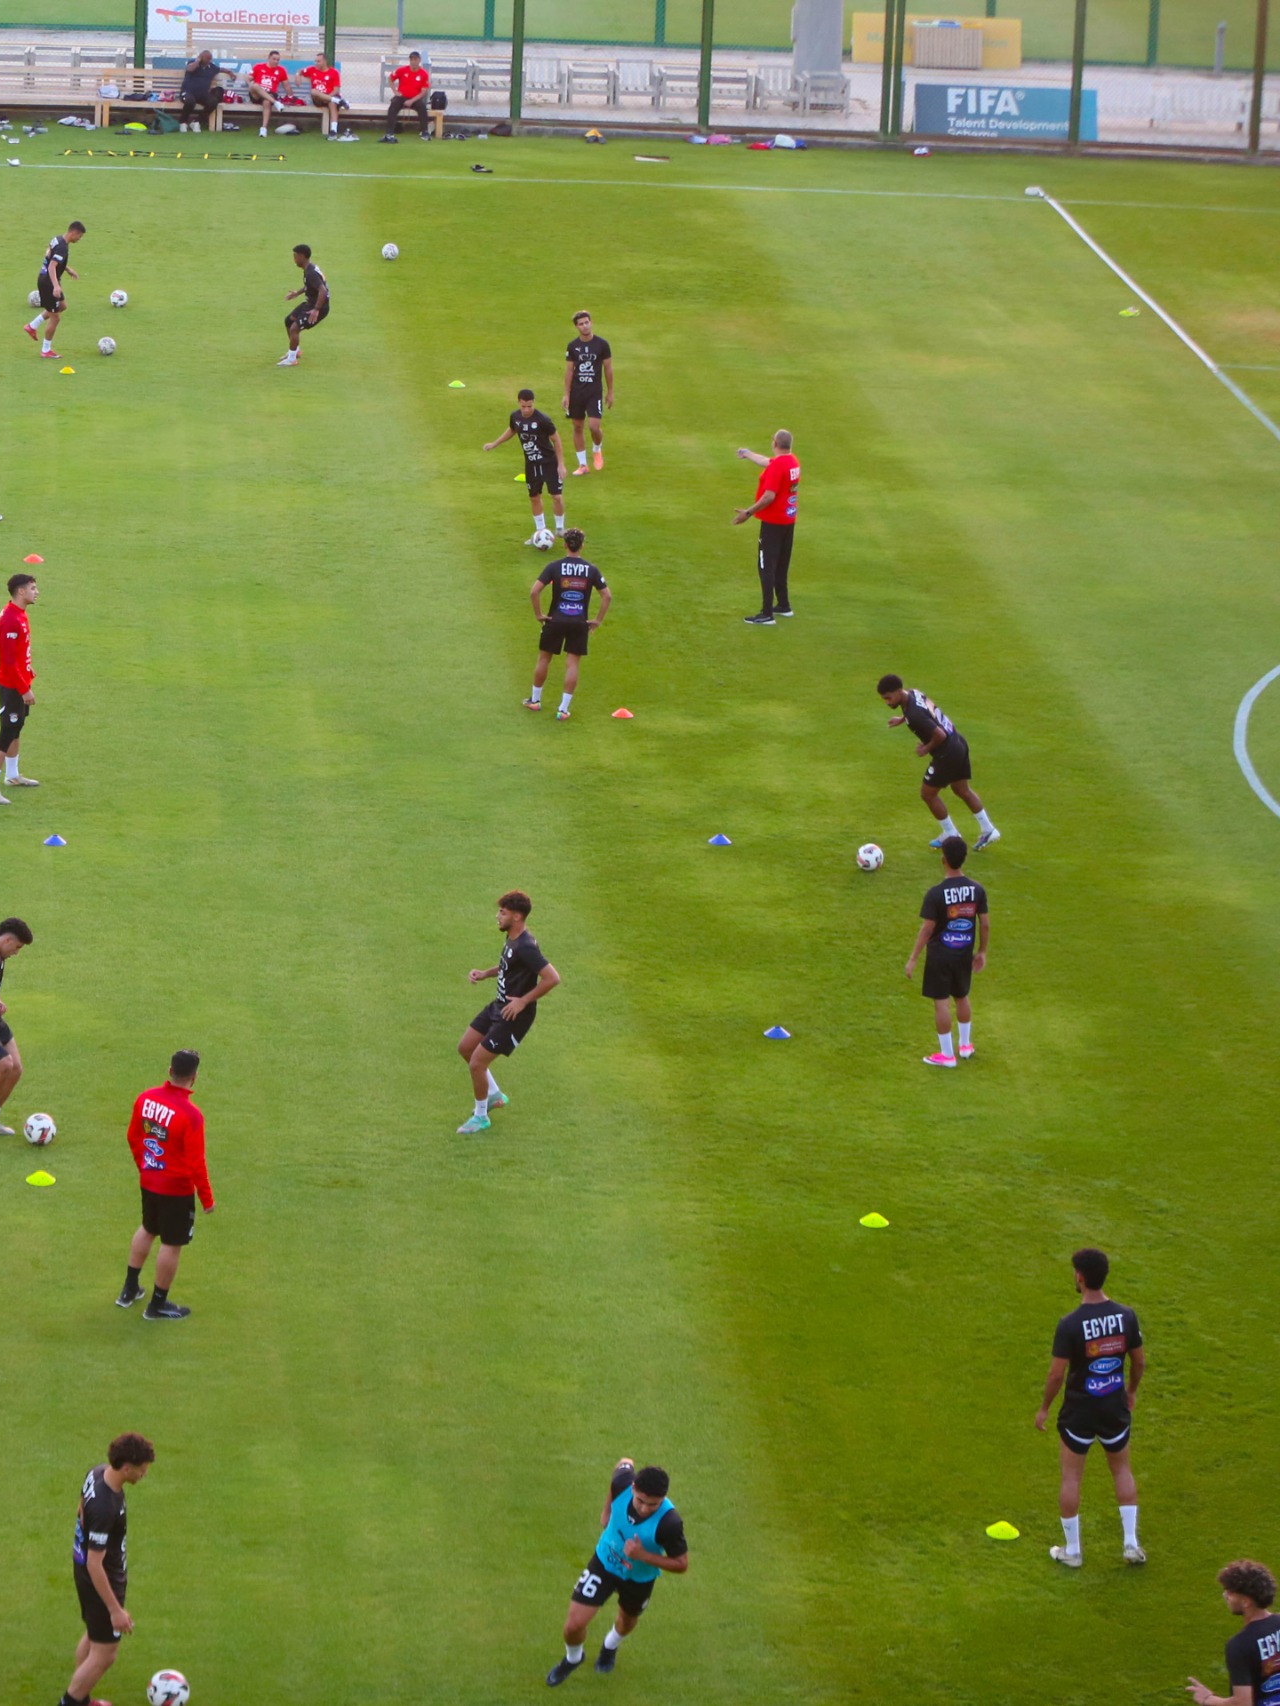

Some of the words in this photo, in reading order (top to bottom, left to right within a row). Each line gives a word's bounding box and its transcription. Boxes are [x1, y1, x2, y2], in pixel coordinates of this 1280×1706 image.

[196, 9, 310, 26] TotalEnergies
[947, 116, 986, 130] Talent
[988, 118, 1069, 133] Development
[561, 563, 589, 577] EGYPT
[943, 886, 975, 905] EGYPT
[142, 1098, 176, 1127] EGYPT
[1082, 1313, 1124, 1341] EGYPT
[1257, 1630, 1280, 1661] EGY
